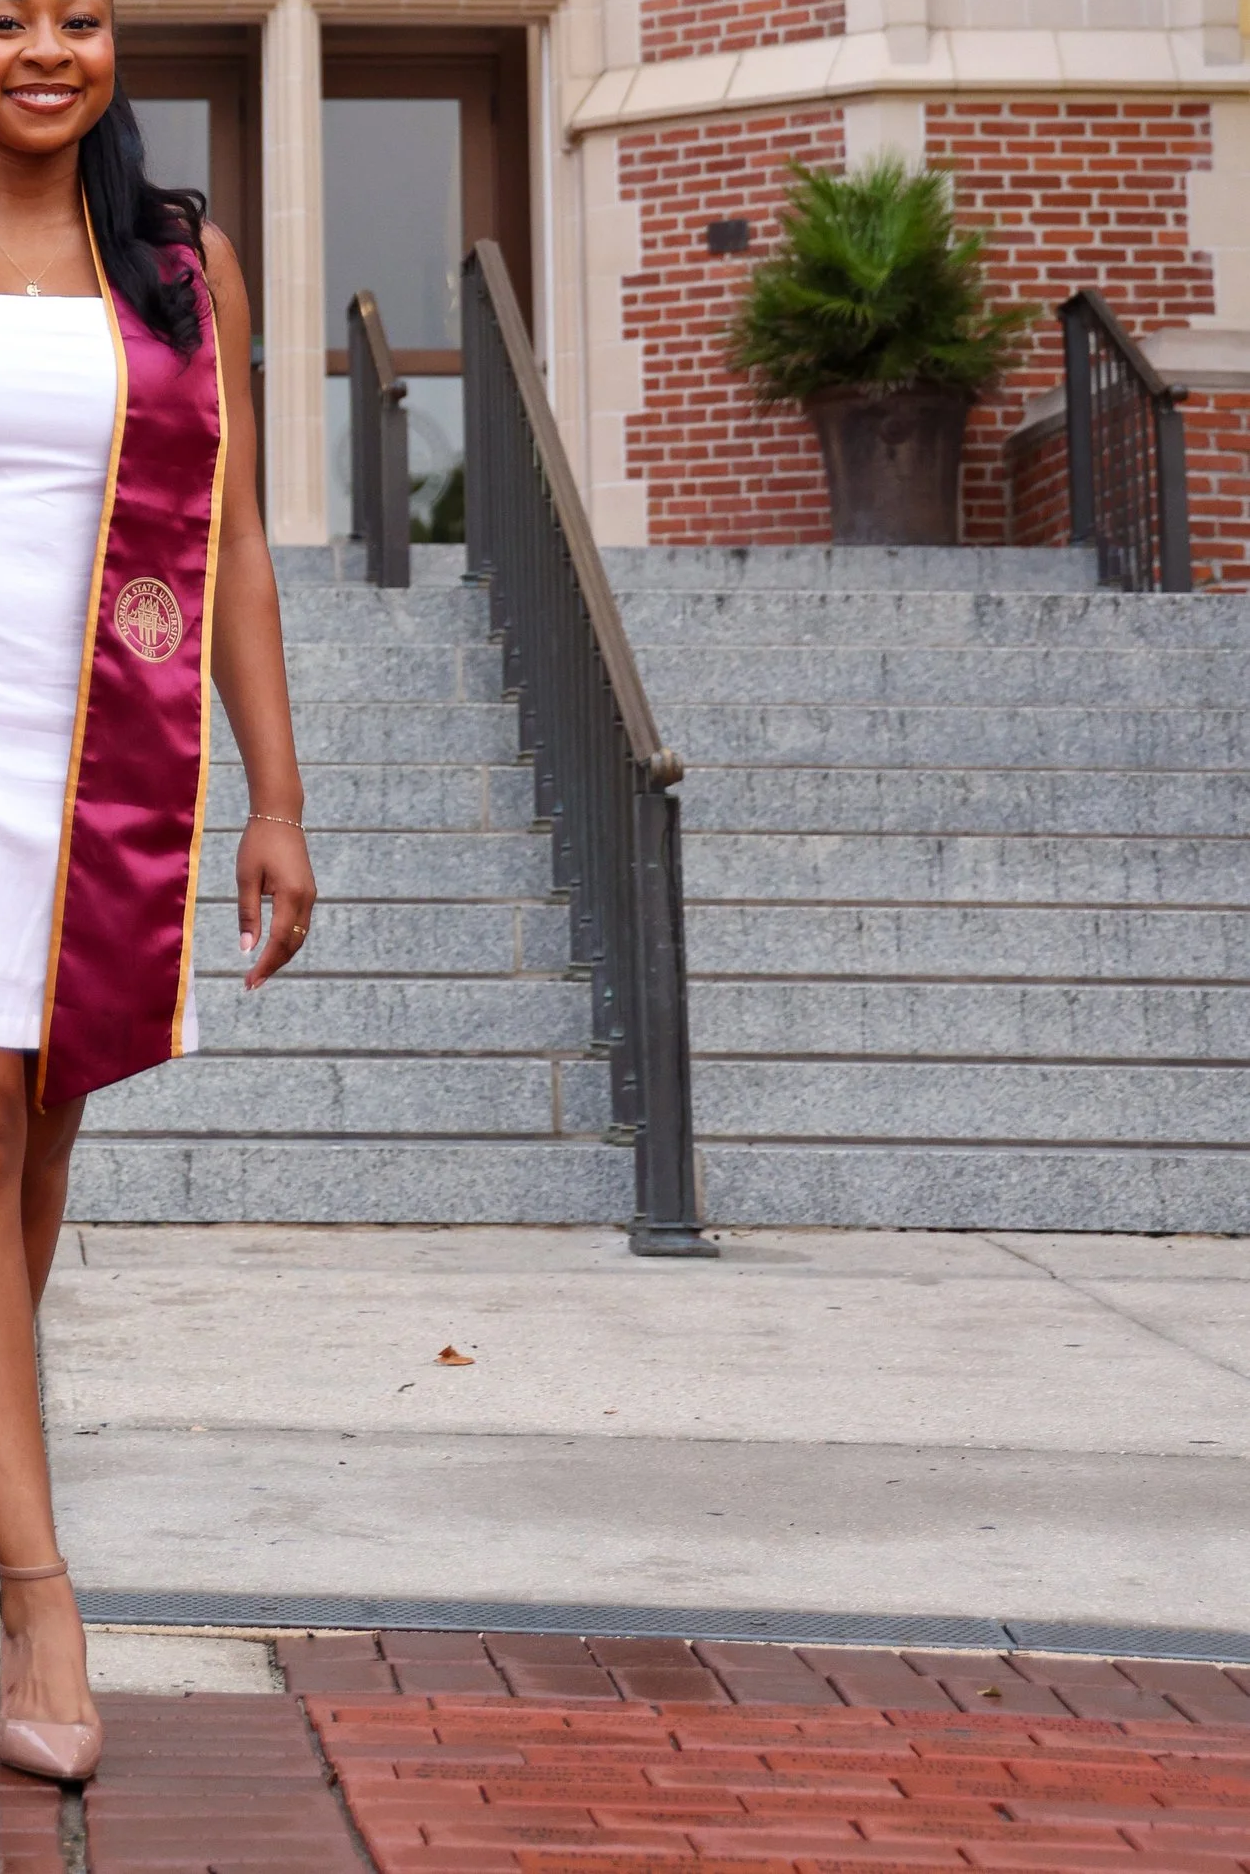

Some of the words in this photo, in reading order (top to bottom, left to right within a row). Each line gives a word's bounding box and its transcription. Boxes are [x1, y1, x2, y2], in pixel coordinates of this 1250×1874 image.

[118, 593, 132, 636] FLORIDA
[132, 583, 158, 594] STATE
[159, 590, 178, 649] UNIVERSITY
